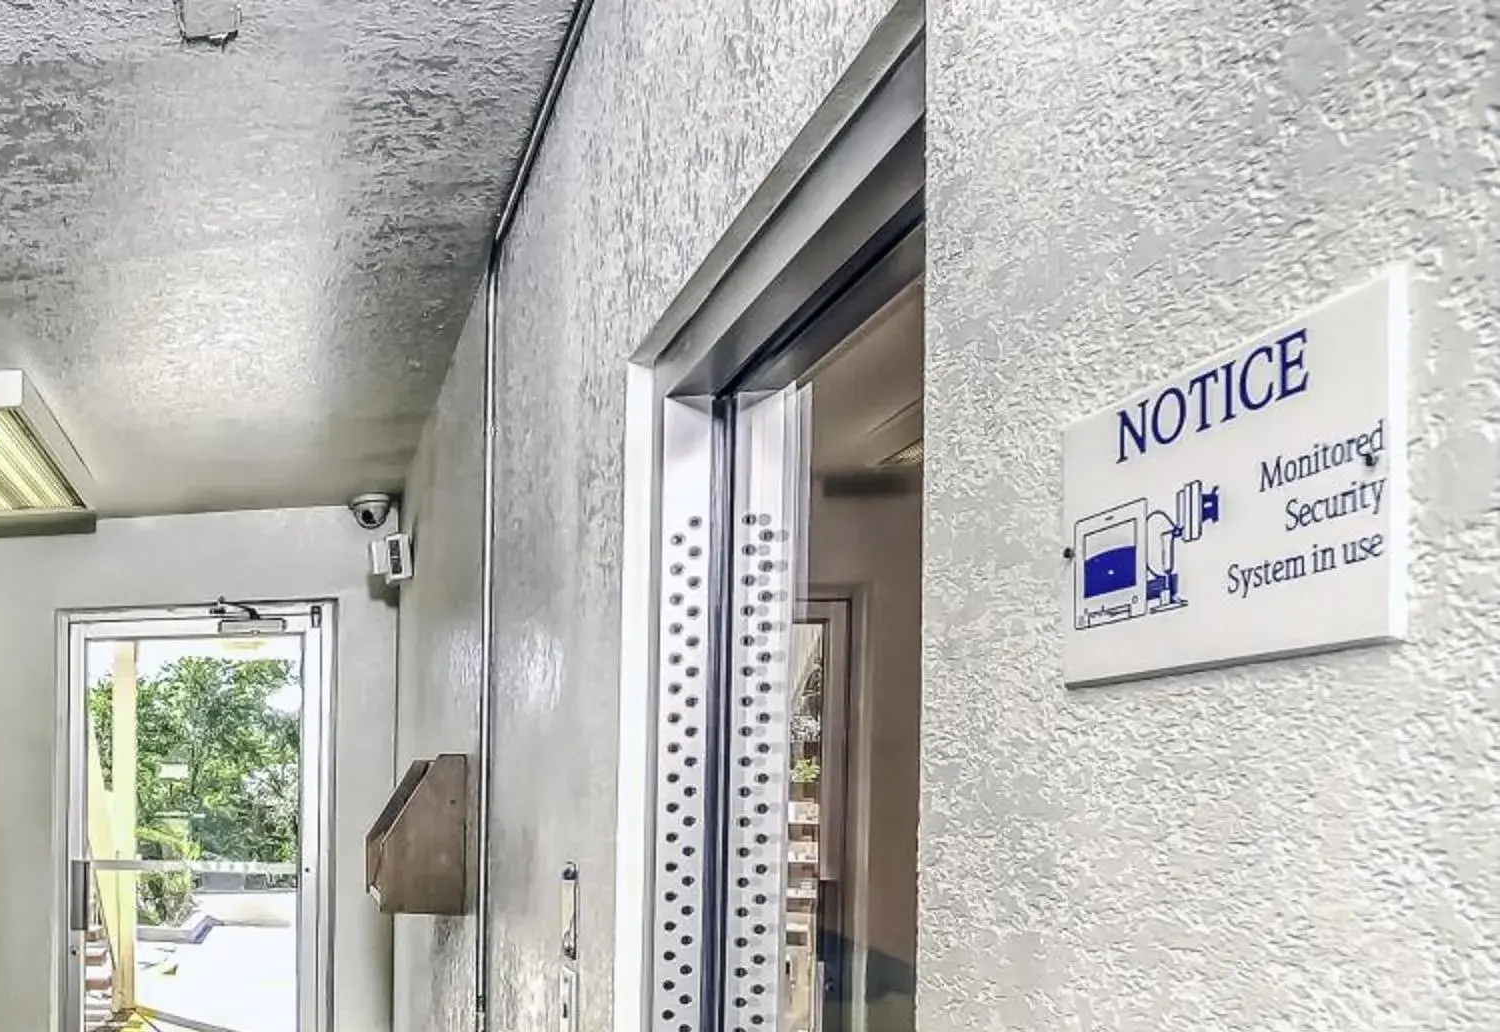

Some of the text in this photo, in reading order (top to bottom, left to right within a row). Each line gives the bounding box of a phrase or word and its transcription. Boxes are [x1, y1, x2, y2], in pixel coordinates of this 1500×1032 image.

[1116, 328, 1309, 464] NOTICE
[1260, 419, 1385, 493] Monitored
[1285, 478, 1387, 531] Security
[1227, 533, 1384, 599] System in use
